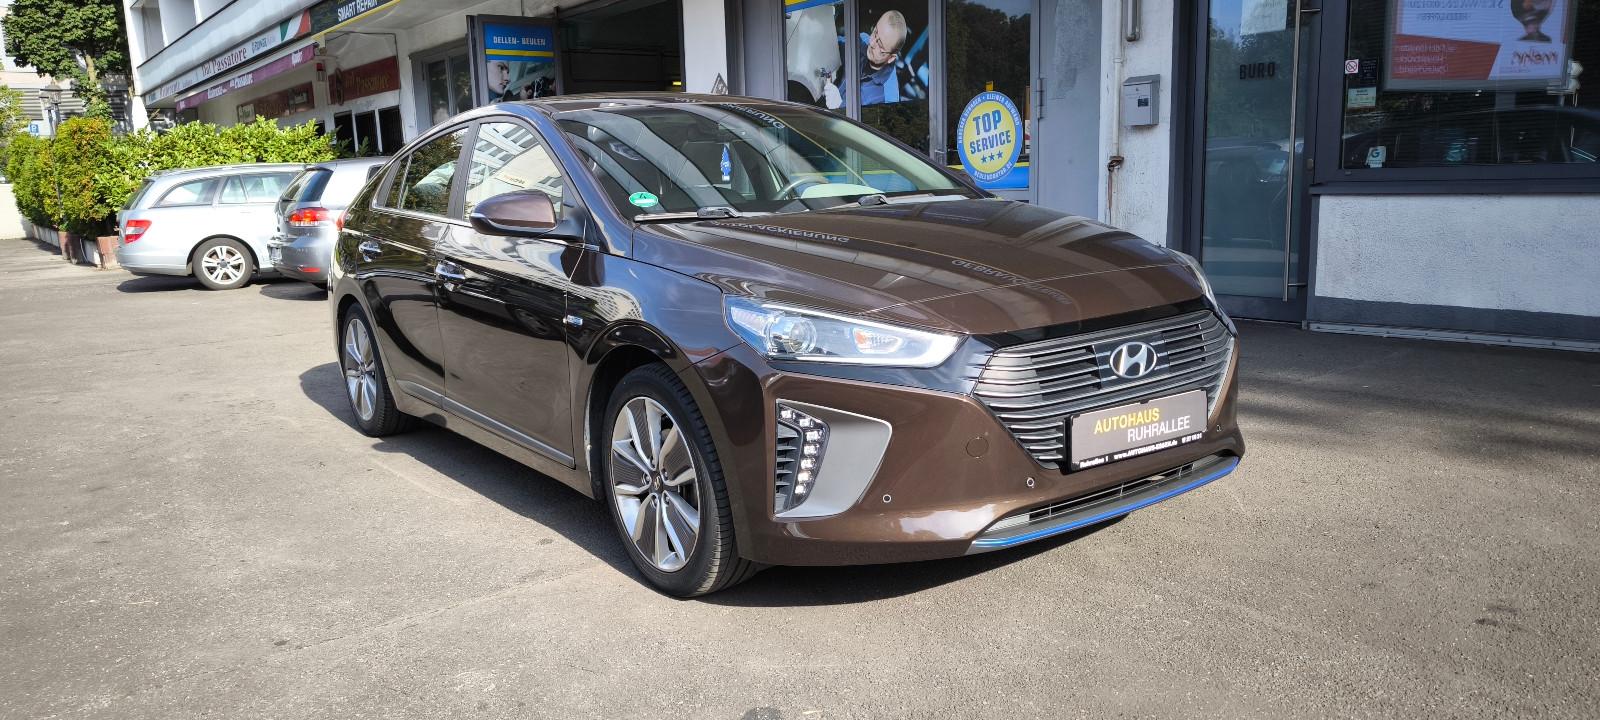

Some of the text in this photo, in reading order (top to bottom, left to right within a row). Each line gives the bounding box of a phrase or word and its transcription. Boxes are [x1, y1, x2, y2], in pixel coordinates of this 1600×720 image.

[337, 2, 356, 22] SMART
[212, 47, 247, 74] Passatore
[973, 110, 1002, 136] TOP
[969, 130, 1011, 154] SERVICE
[1094, 407, 1160, 435] AUTOHAUS
[1127, 415, 1191, 443] RUHRALLEE
